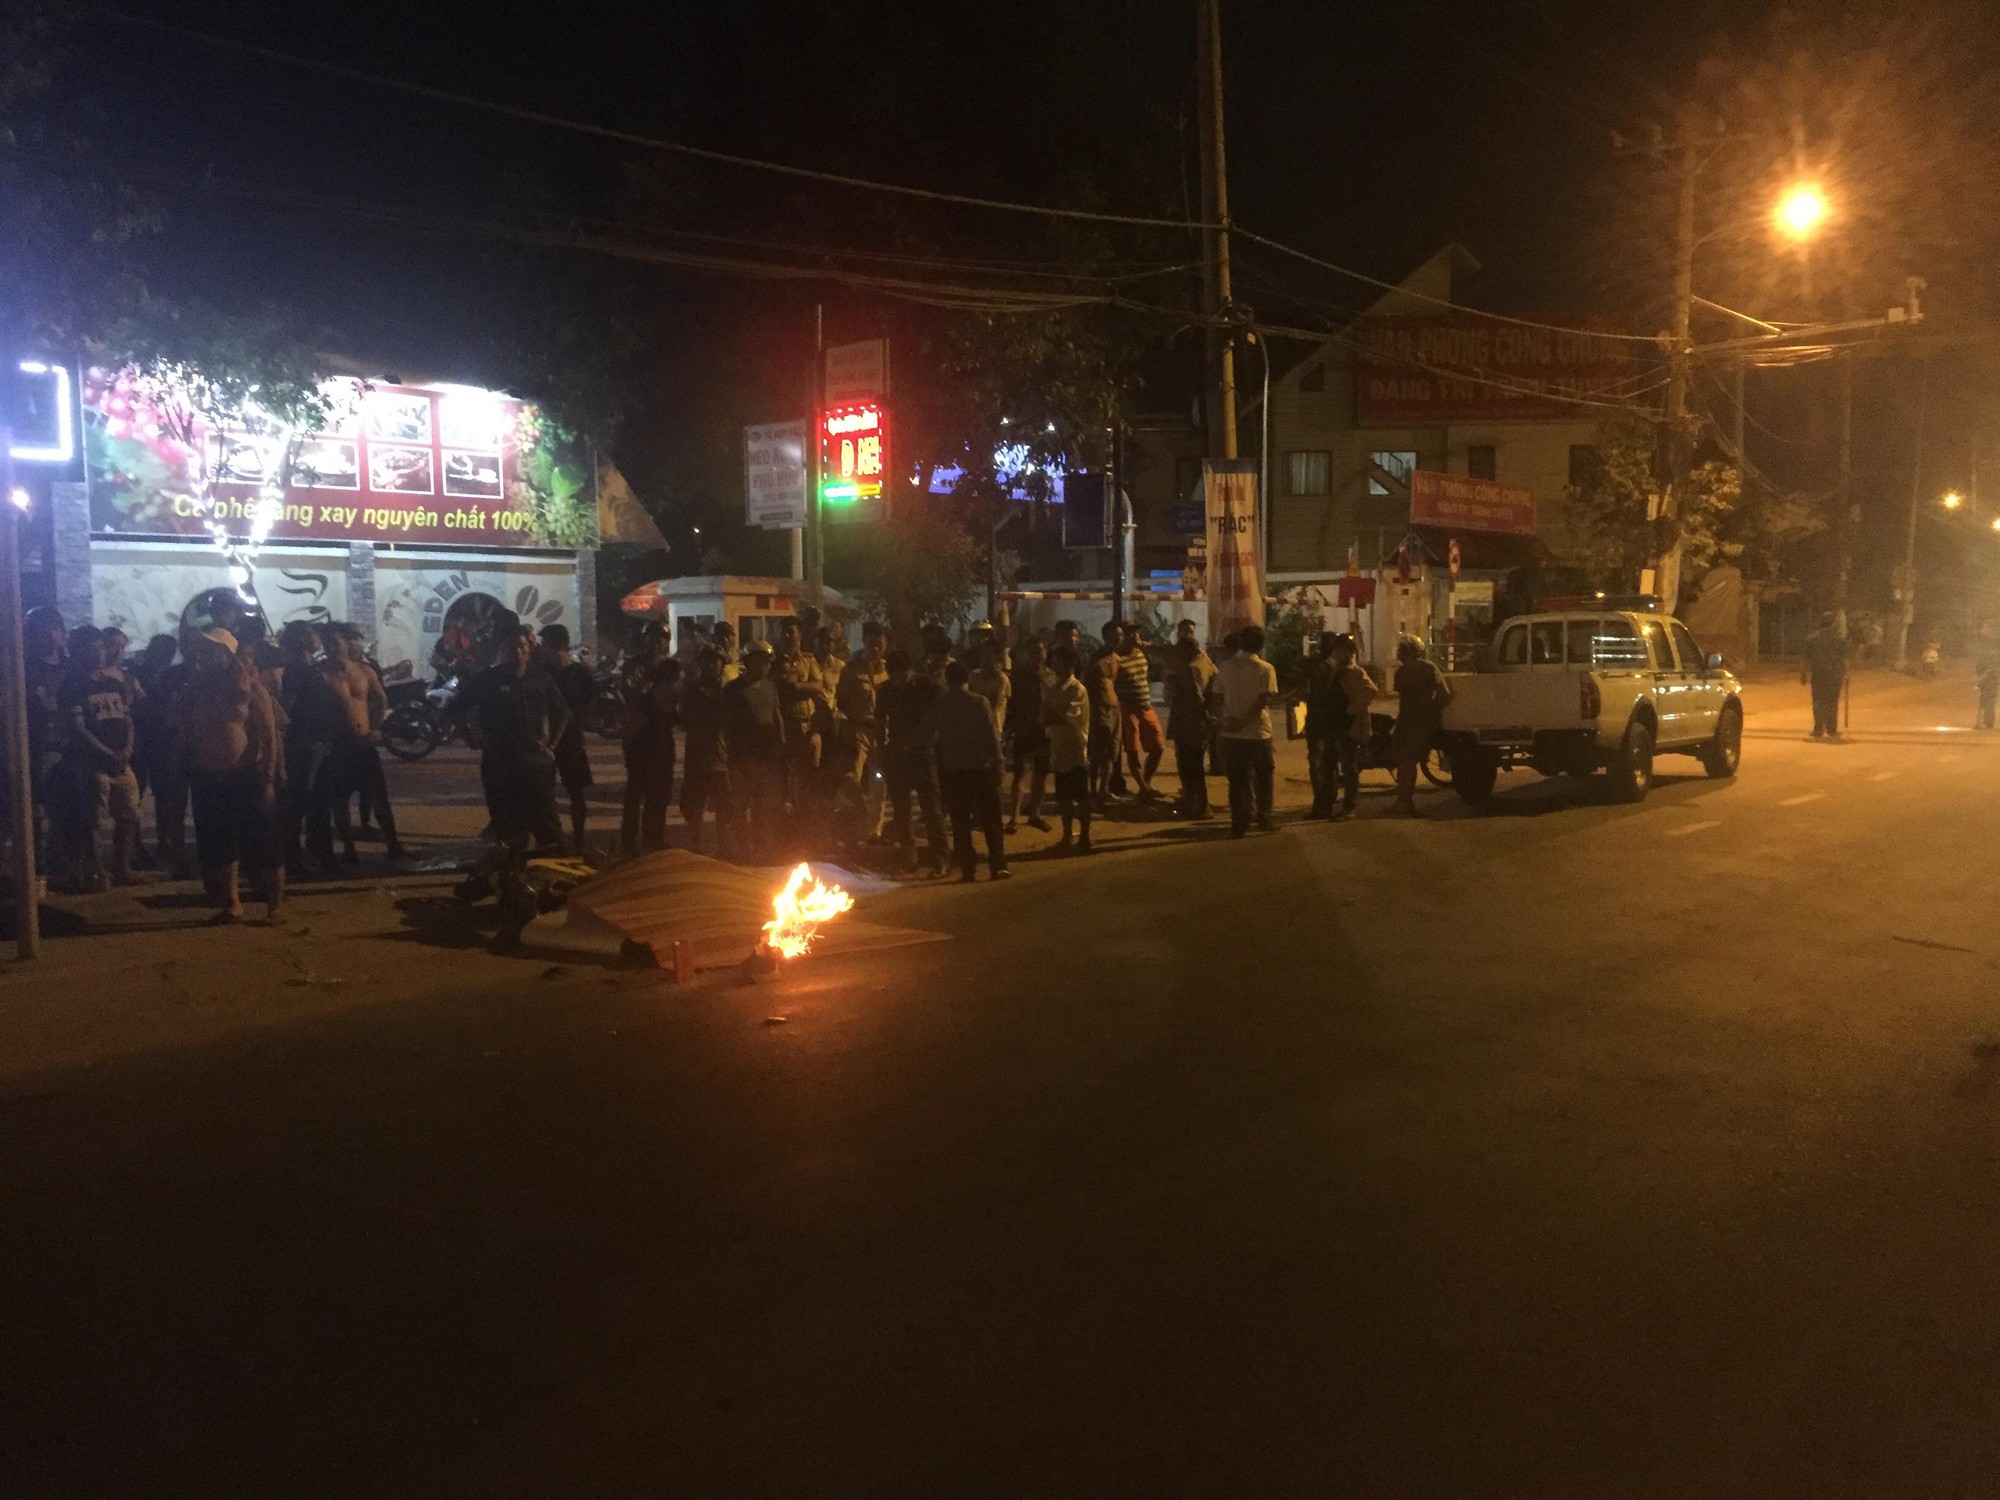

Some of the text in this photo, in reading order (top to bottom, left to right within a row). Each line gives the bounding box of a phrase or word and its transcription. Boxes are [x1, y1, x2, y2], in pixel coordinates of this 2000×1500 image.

[266, 503, 313, 527] ang
[319, 506, 357, 529] xay
[363, 506, 438, 531] nguyên
[444, 505, 486, 530] chất
[491, 511, 539, 532] 100%
[422, 571, 470, 632] EDEN
